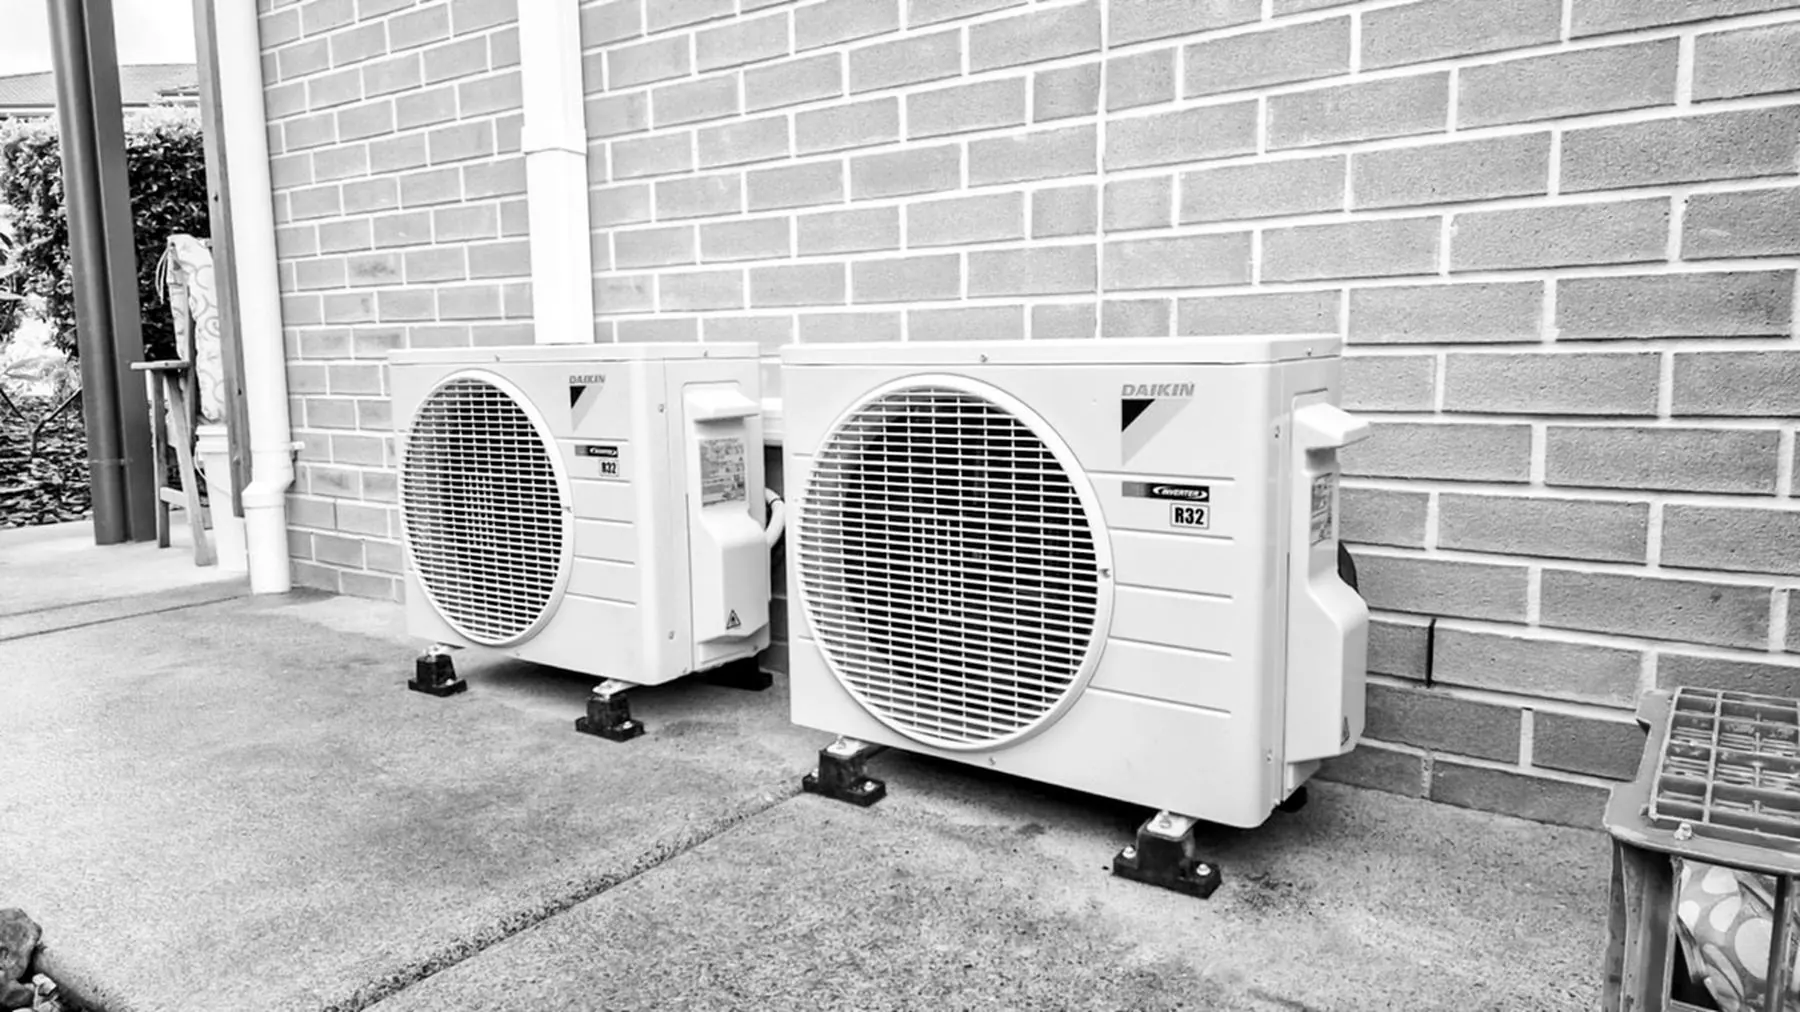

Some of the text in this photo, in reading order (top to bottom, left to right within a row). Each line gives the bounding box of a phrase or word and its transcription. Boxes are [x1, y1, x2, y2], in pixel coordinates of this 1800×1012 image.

[569, 375, 605, 384] DAIKIN
[1121, 383, 1195, 397] DAIKIN
[1161, 489, 1200, 497] INVERTER
[1175, 507, 1204, 525] R32
